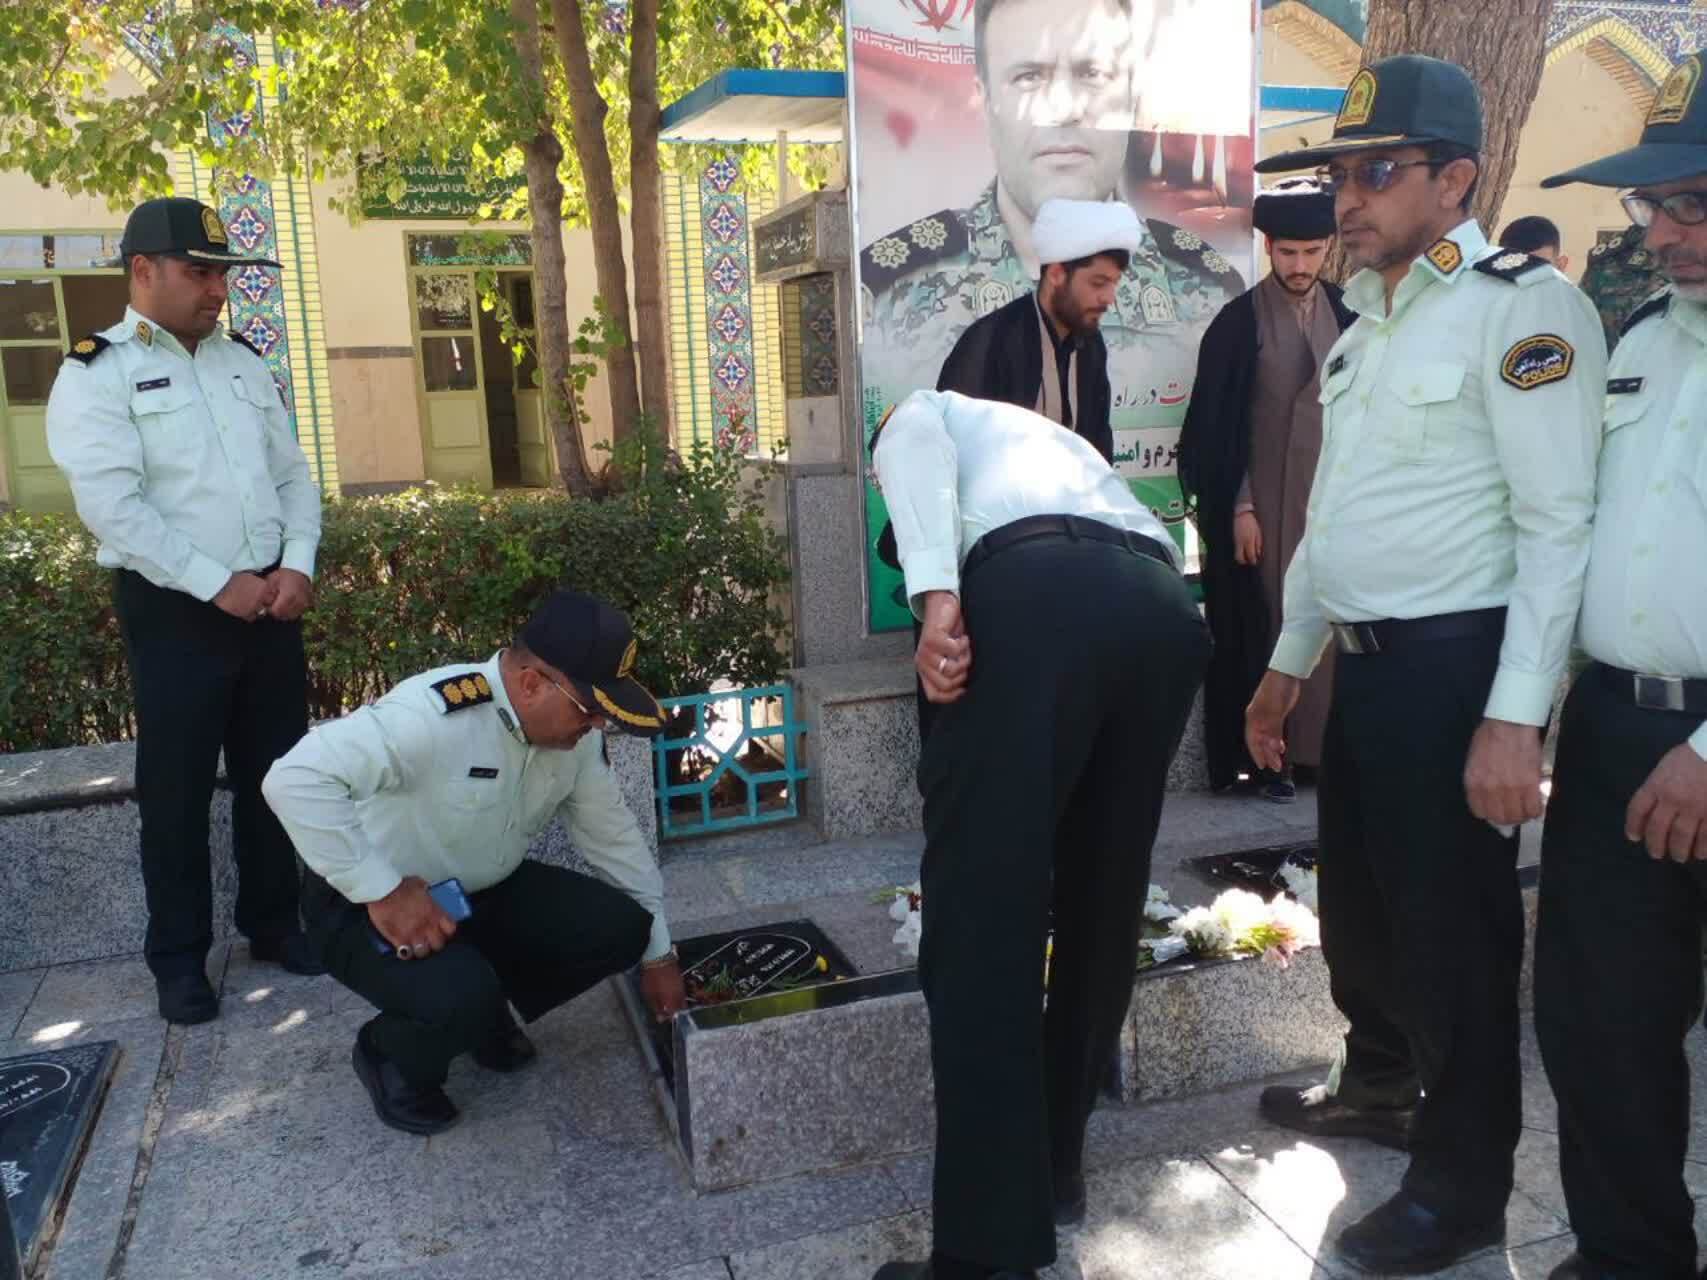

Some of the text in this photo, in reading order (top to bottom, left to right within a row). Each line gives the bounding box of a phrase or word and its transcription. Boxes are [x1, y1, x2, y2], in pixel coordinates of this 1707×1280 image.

[1114, 387, 1138, 407] راه
[1143, 388, 1157, 406] در
[1112, 440, 1140, 468] امنی
[1142, 446, 1151, 468] و
